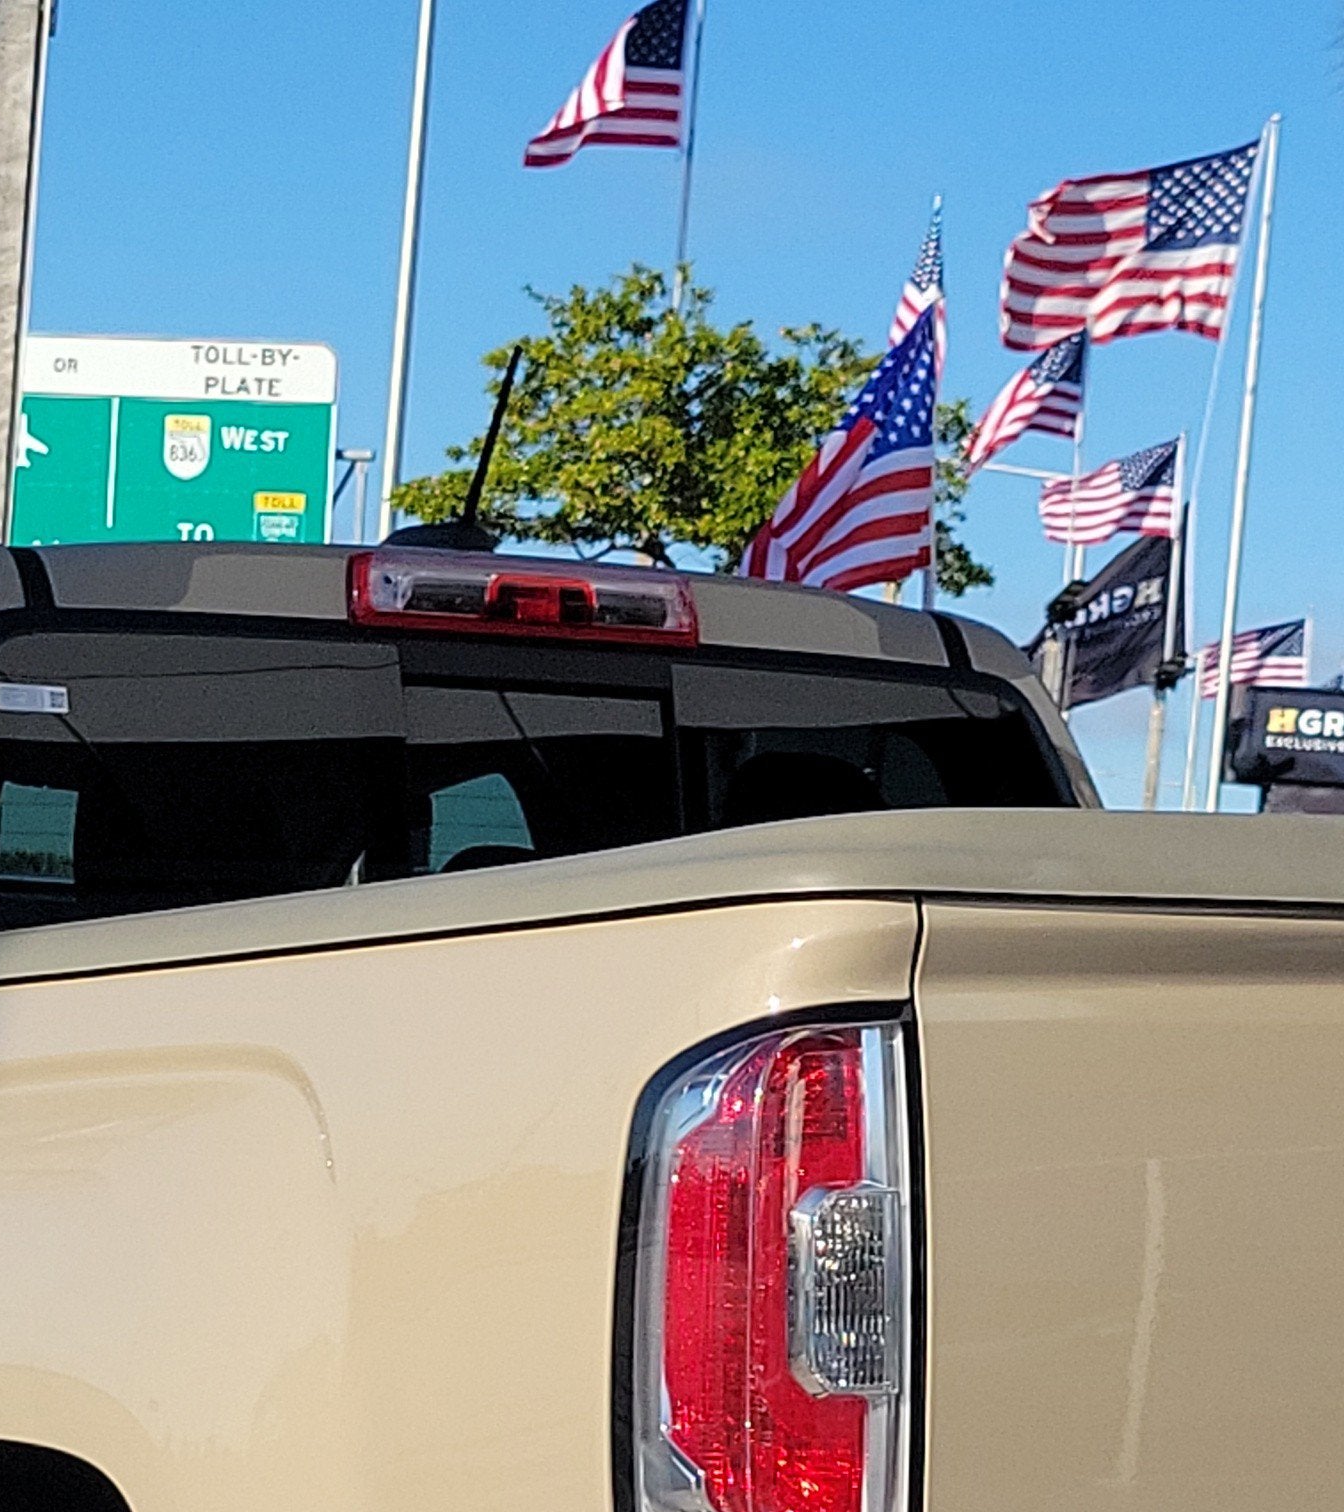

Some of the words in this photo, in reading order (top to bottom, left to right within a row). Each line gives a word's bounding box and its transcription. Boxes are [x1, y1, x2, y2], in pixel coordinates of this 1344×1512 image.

[53, 357, 78, 373] OR
[190, 345, 301, 366] TOLL-BY-
[204, 376, 283, 397] PLATE
[220, 426, 290, 452] WEST
[170, 444, 198, 462] 836
